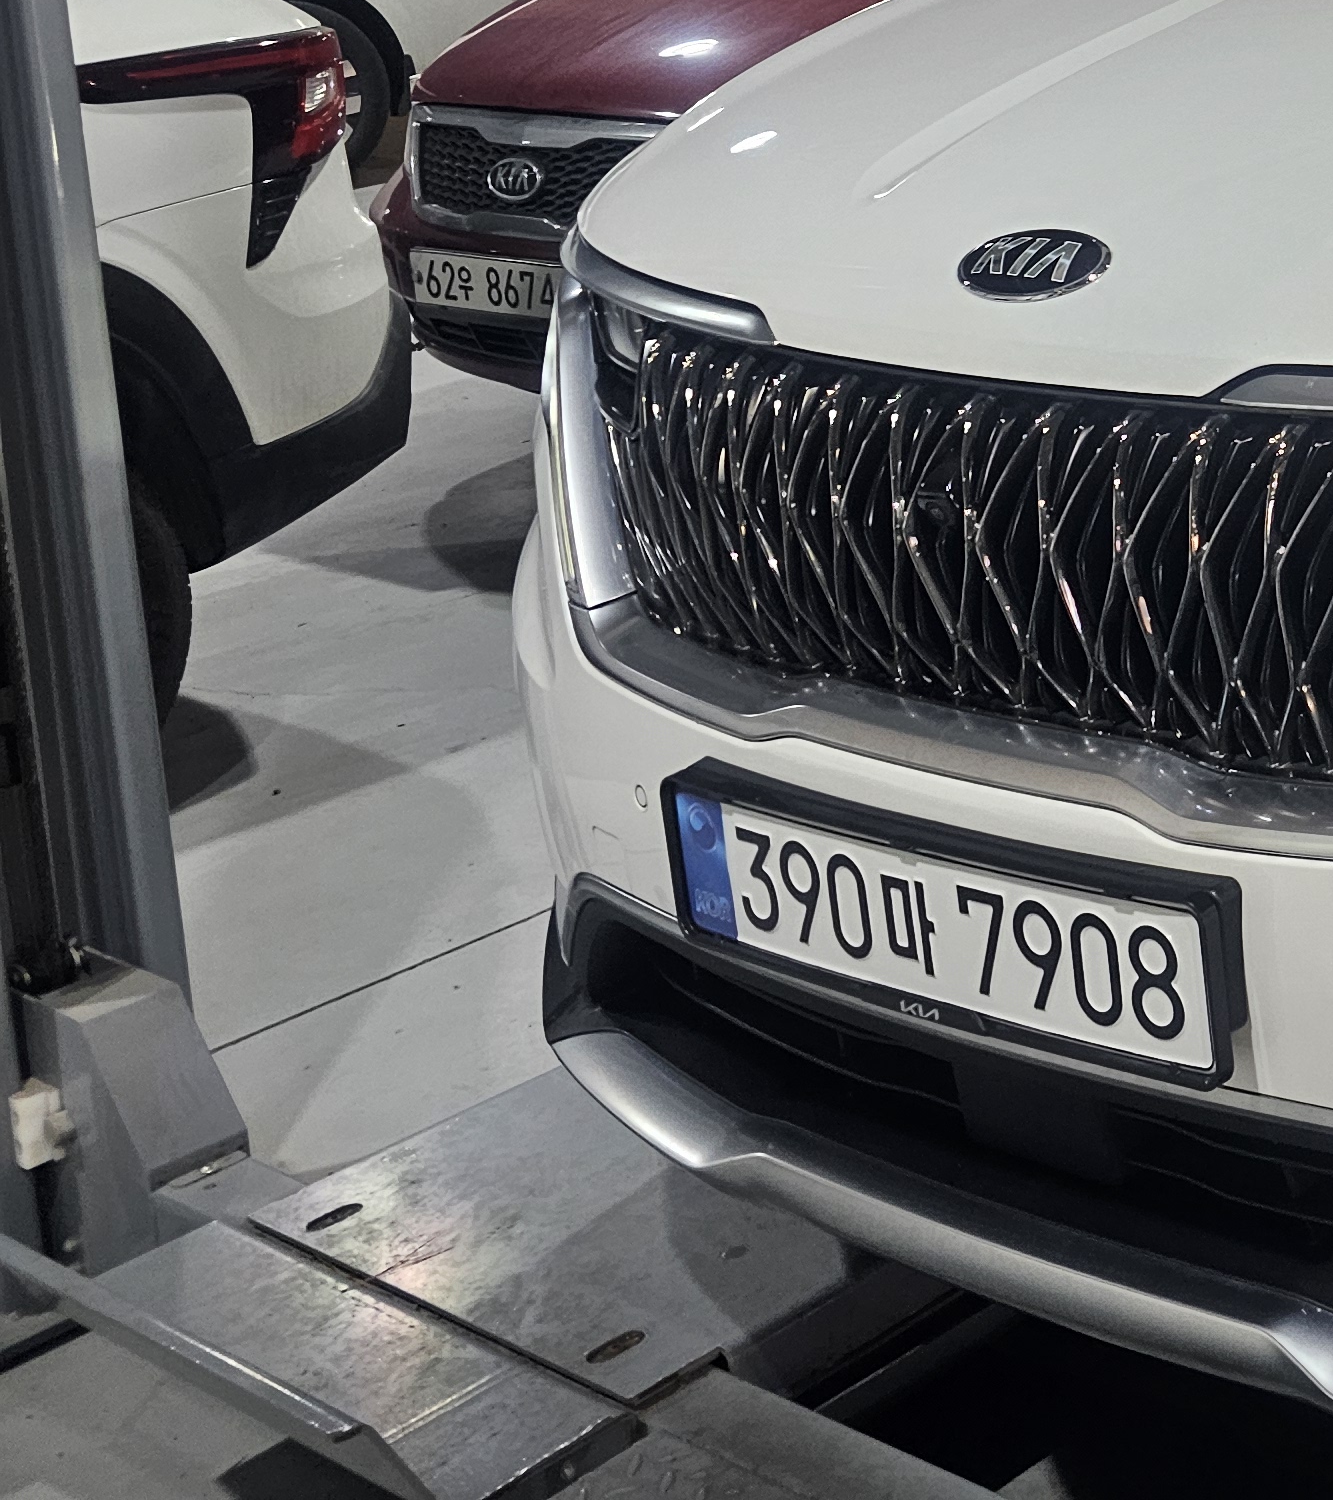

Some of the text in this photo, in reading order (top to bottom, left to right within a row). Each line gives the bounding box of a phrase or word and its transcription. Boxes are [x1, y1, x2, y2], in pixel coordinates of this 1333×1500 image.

[426, 259, 474, 301] 62우
[970, 236, 1083, 283] KIA
[694, 888, 731, 922] KOR
[735, 826, 1186, 1041] 390마 7908
